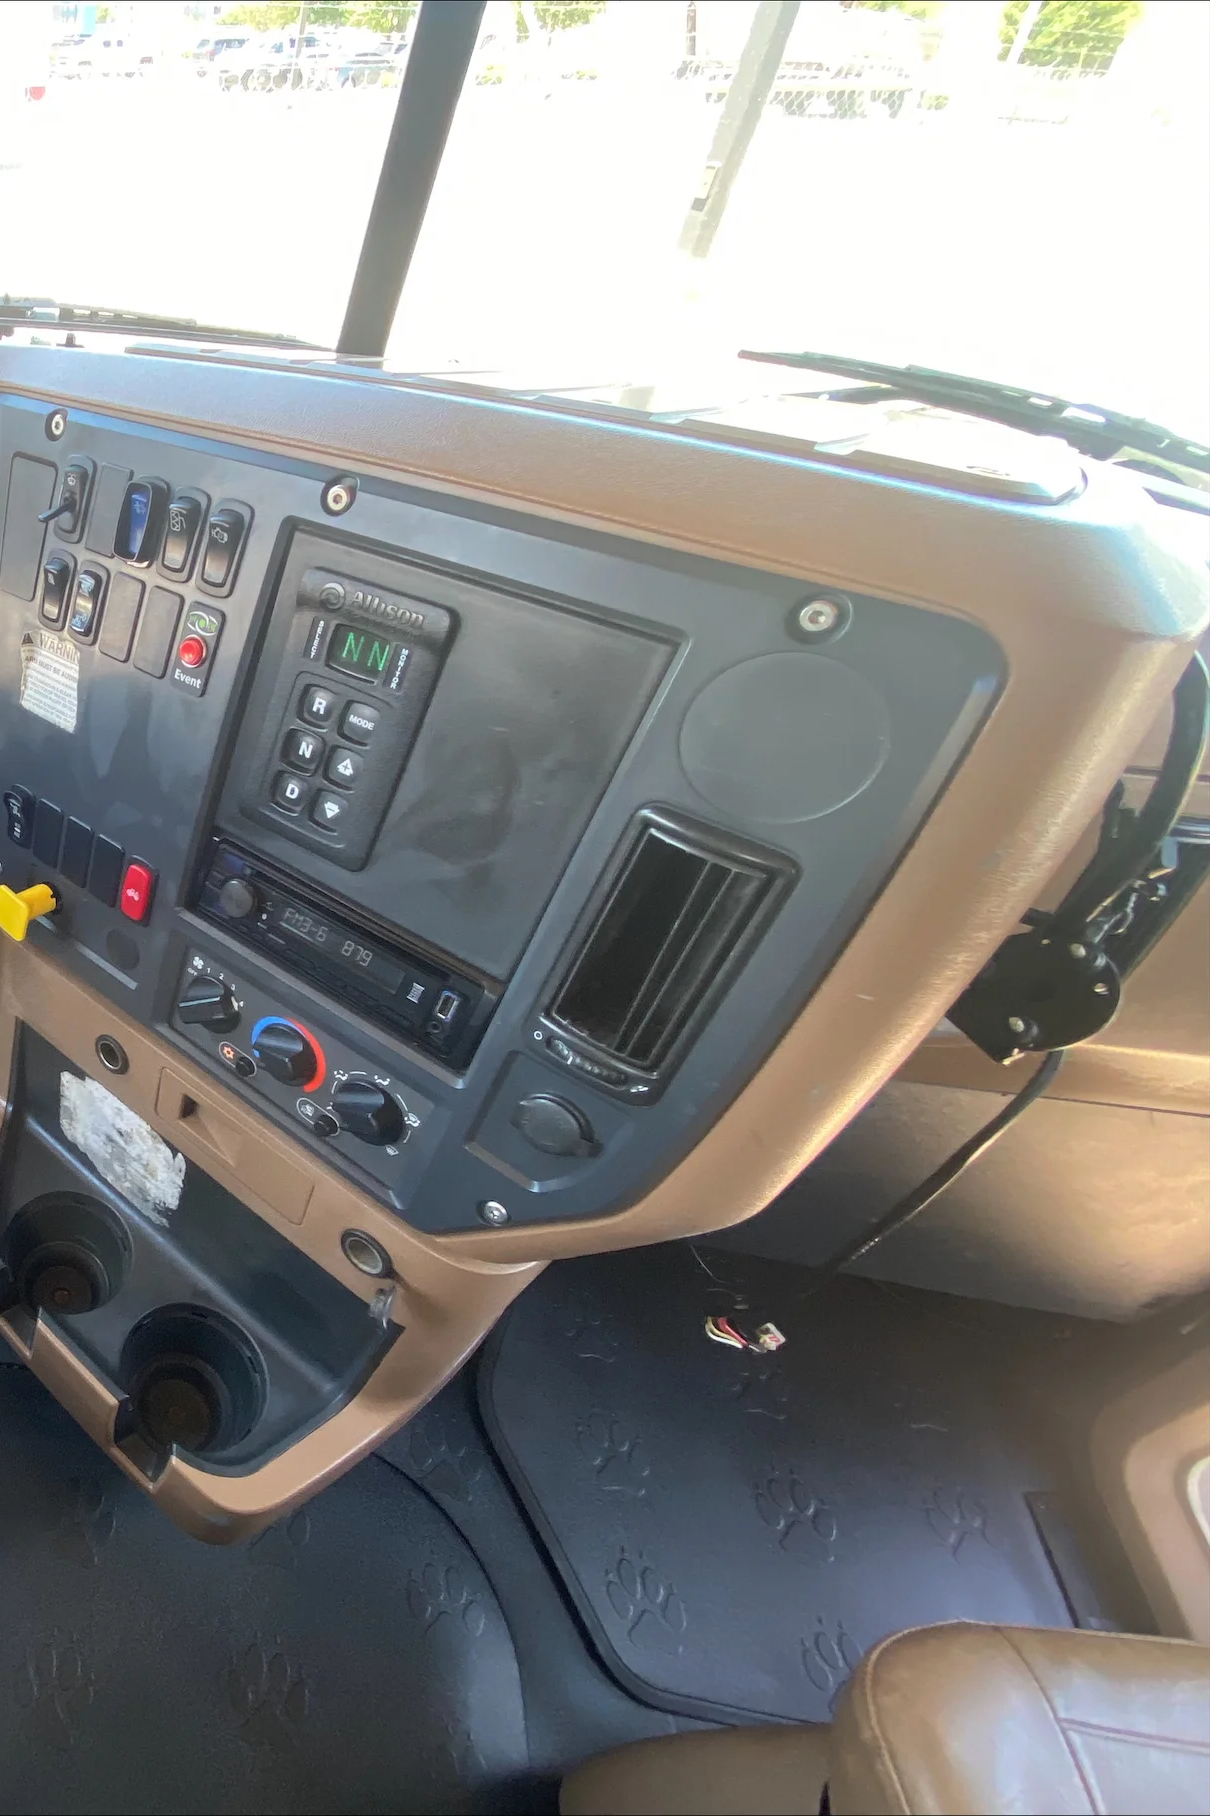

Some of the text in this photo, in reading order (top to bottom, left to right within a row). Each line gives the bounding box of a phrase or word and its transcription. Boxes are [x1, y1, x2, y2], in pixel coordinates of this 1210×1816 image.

[352, 591, 424, 628] Allison
[310, 620, 325, 659] SELECT
[342, 632, 390, 671] N N
[174, 668, 202, 689] Event
[390, 648, 409, 690] MONITOR
[312, 697, 327, 715] R
[349, 714, 376, 731] MODE
[298, 741, 314, 759] N
[285, 783, 299, 799] D
[341, 940, 373, 967] 879
